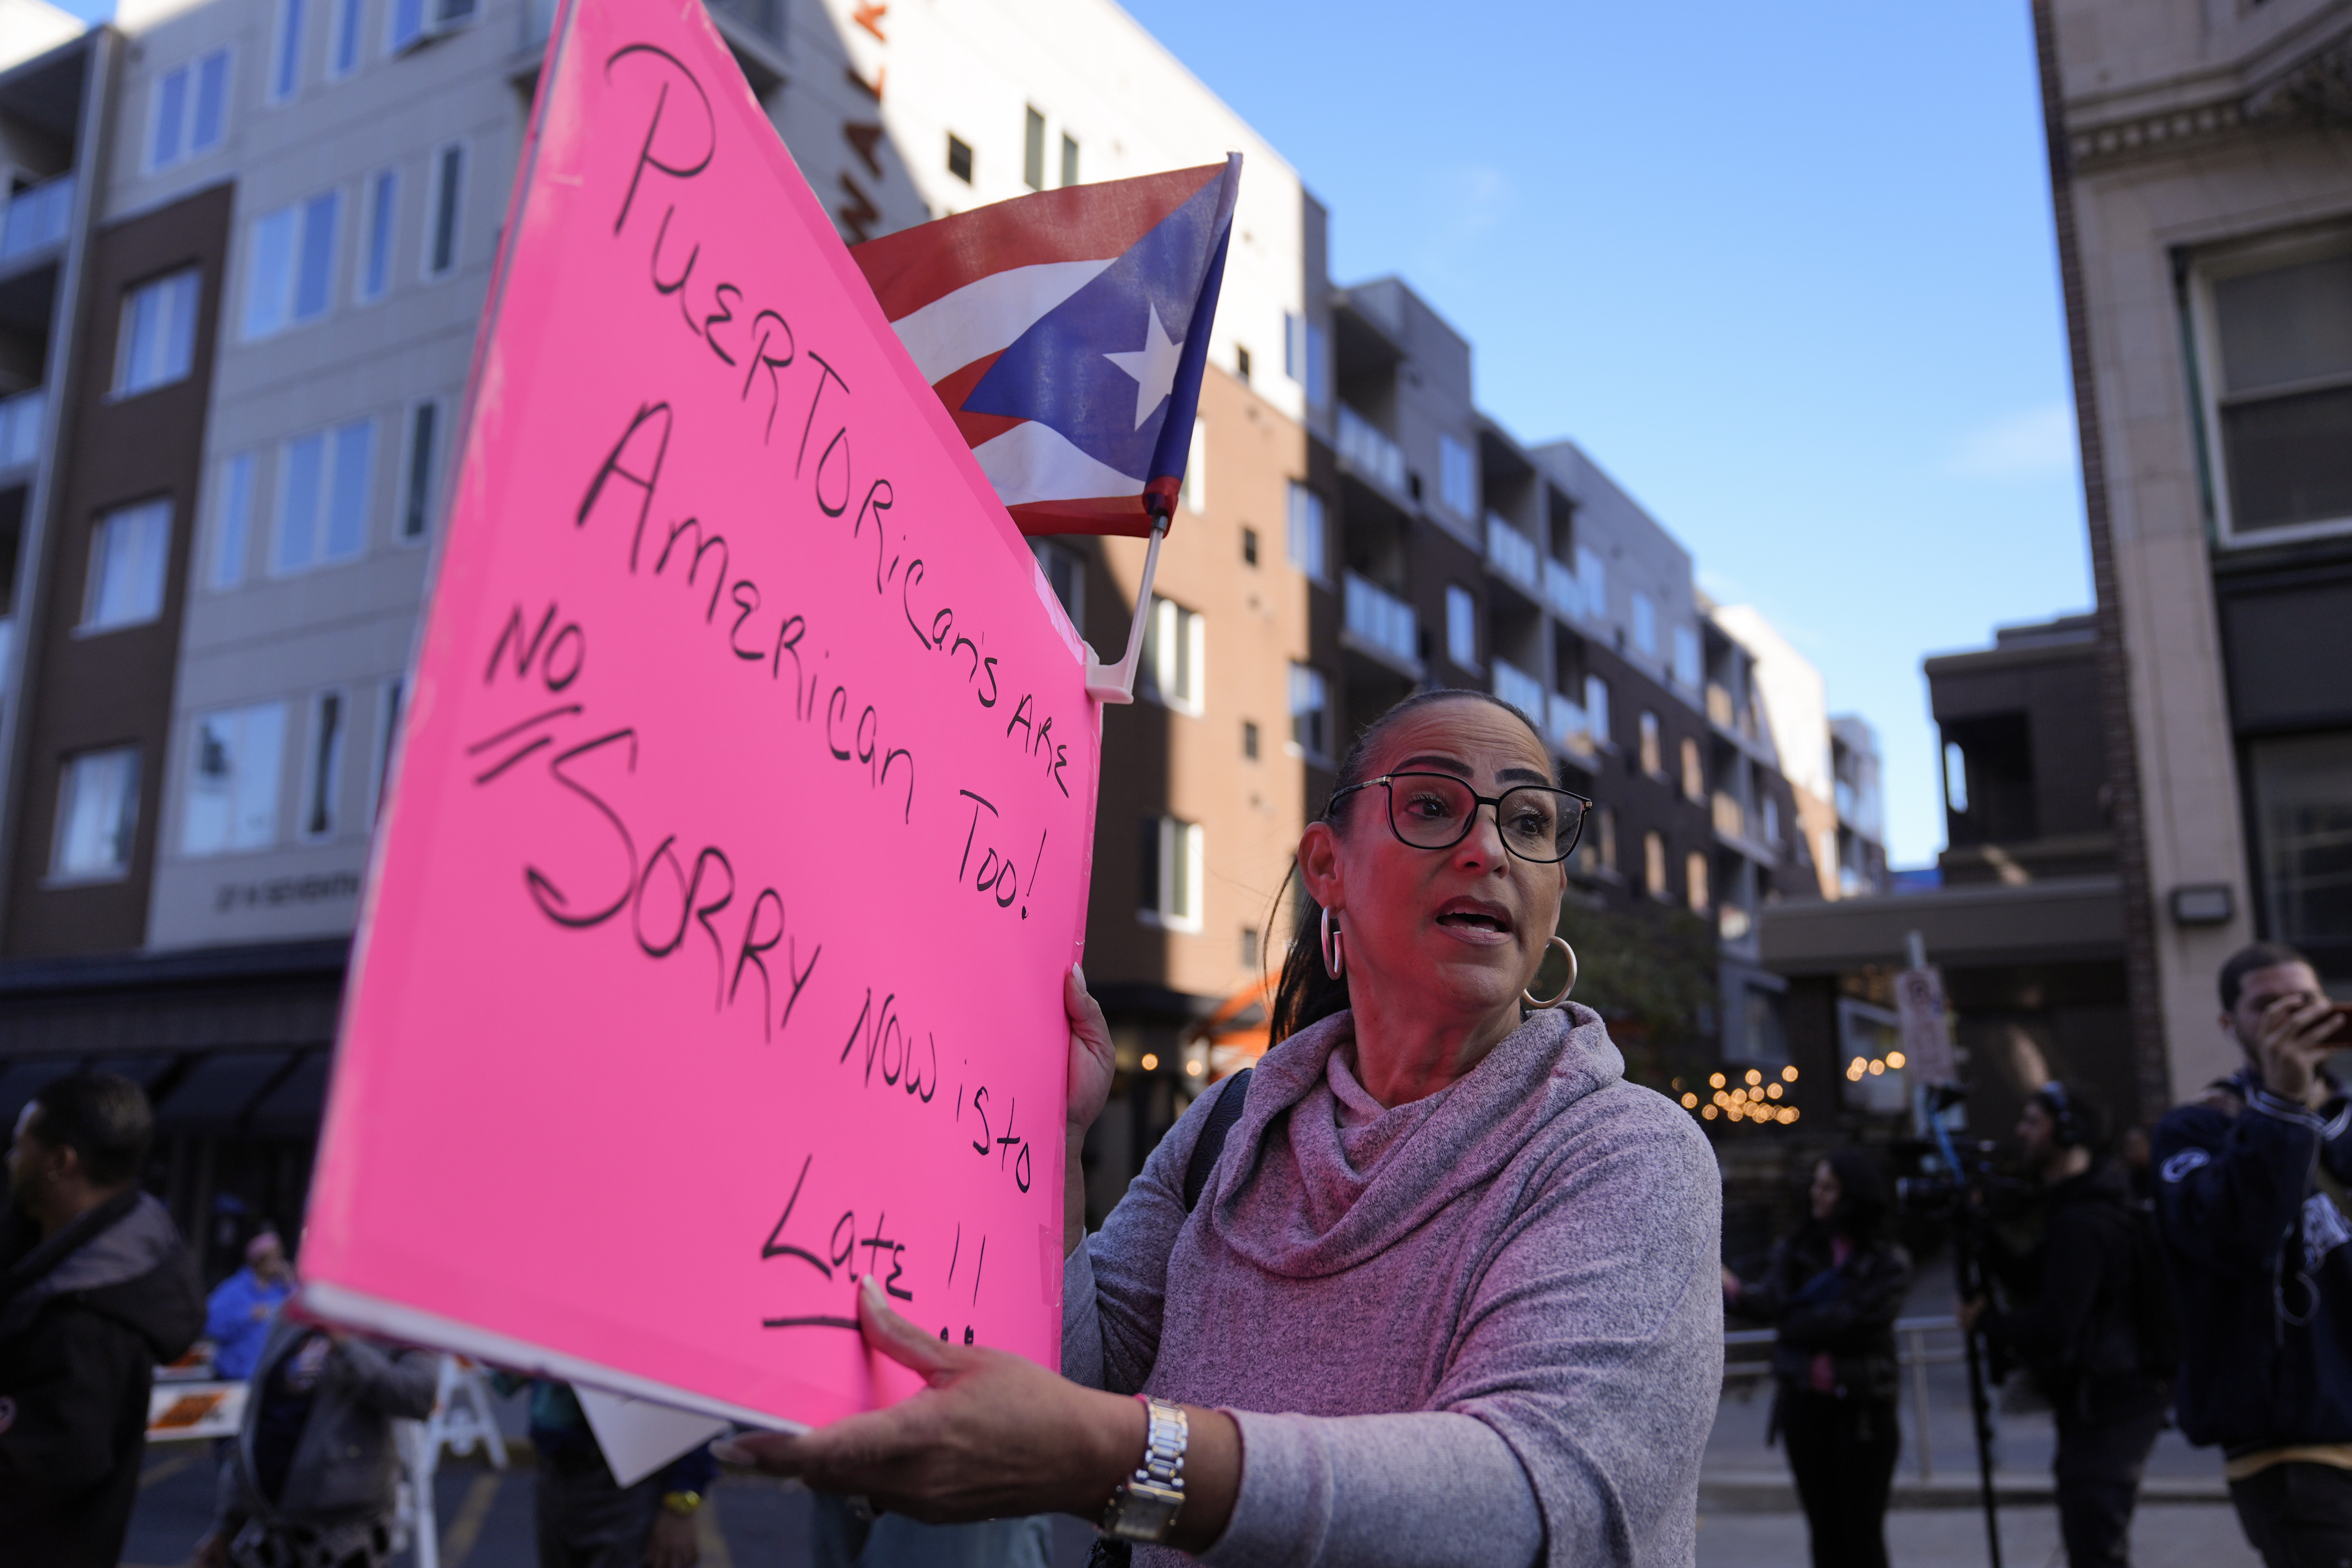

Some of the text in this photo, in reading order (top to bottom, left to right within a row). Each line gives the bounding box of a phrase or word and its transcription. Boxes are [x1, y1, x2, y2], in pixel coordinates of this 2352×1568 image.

[483, 601, 585, 695] NO
[1006, 693, 1070, 799] ARE
[523, 726, 822, 1046] SORRY
